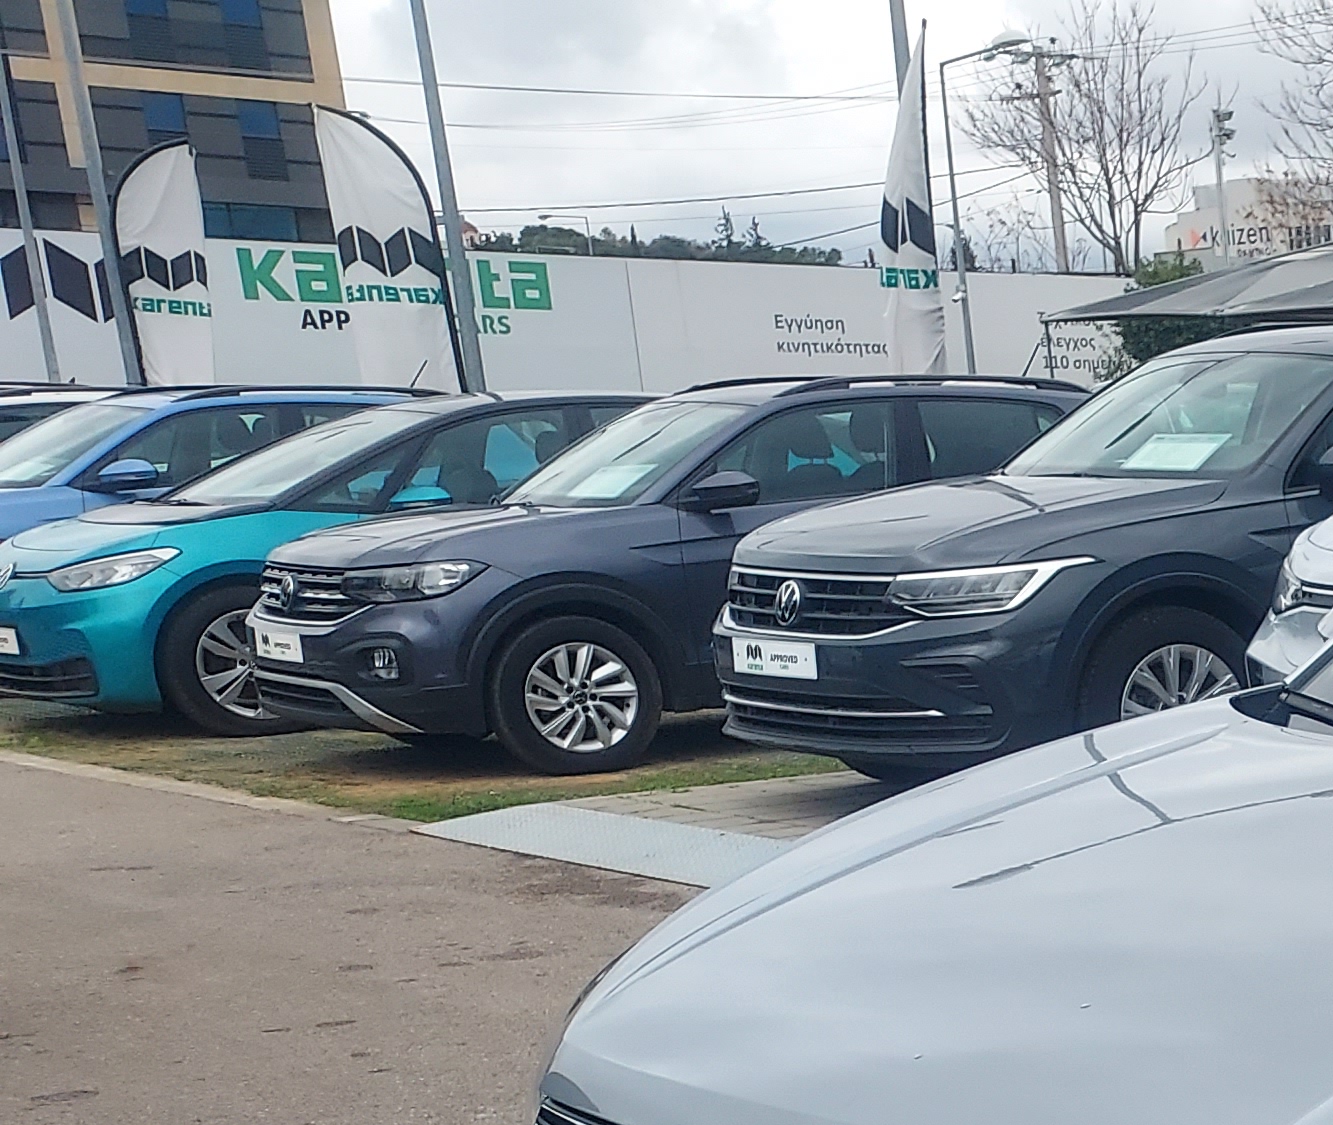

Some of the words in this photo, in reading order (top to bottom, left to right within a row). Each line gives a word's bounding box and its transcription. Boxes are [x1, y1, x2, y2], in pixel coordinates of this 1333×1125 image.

[1210, 223, 1271, 247] kizen
[774, 313, 845, 335] Εγγύηση
[776, 338, 888, 357] κινητικότητας
